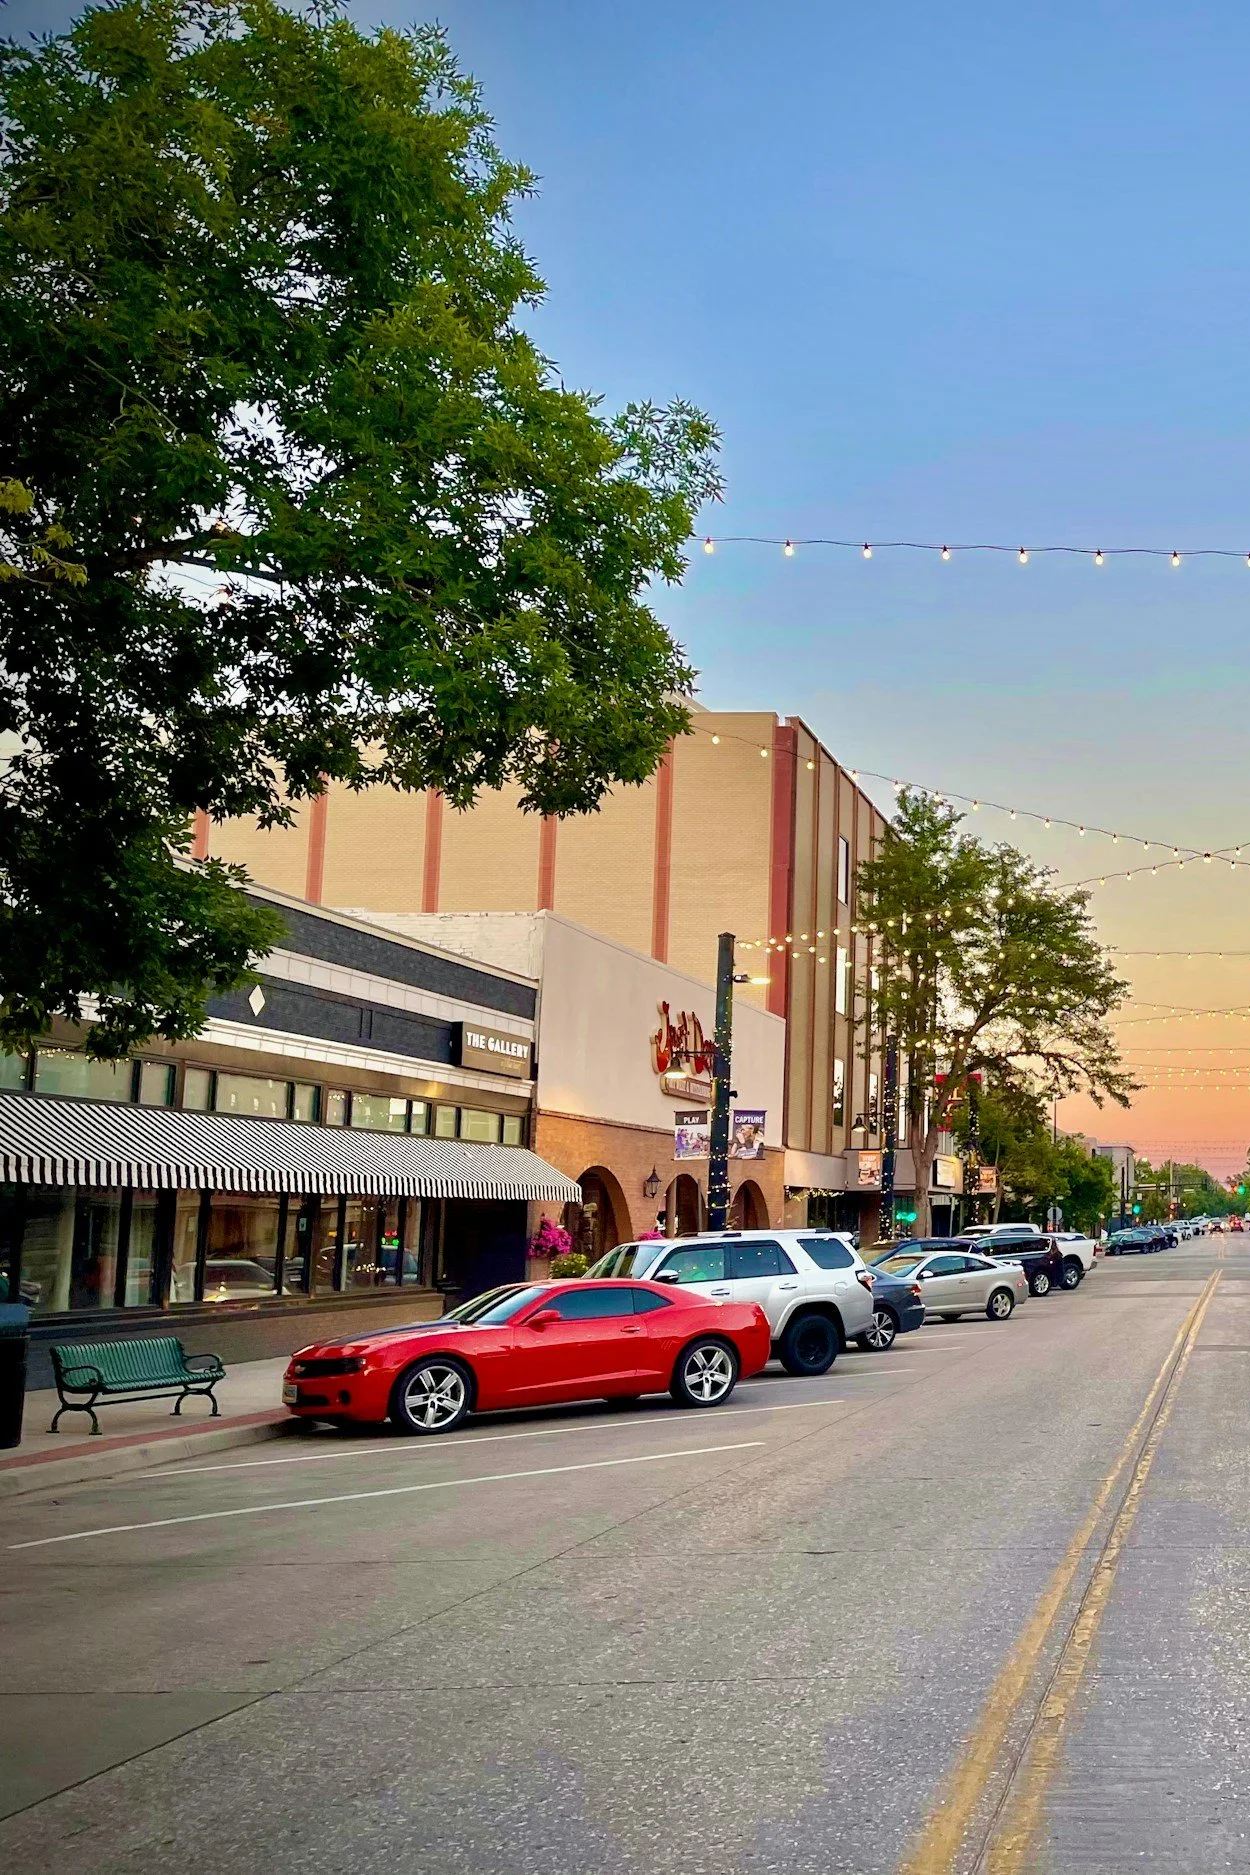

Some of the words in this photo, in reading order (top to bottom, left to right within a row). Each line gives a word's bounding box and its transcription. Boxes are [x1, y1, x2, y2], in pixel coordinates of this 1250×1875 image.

[466, 1032, 486, 1050] THE
[487, 1037, 529, 1059] GALLERY
[683, 1116, 700, 1124] PLAY
[734, 1115, 764, 1124] CAPTURE
